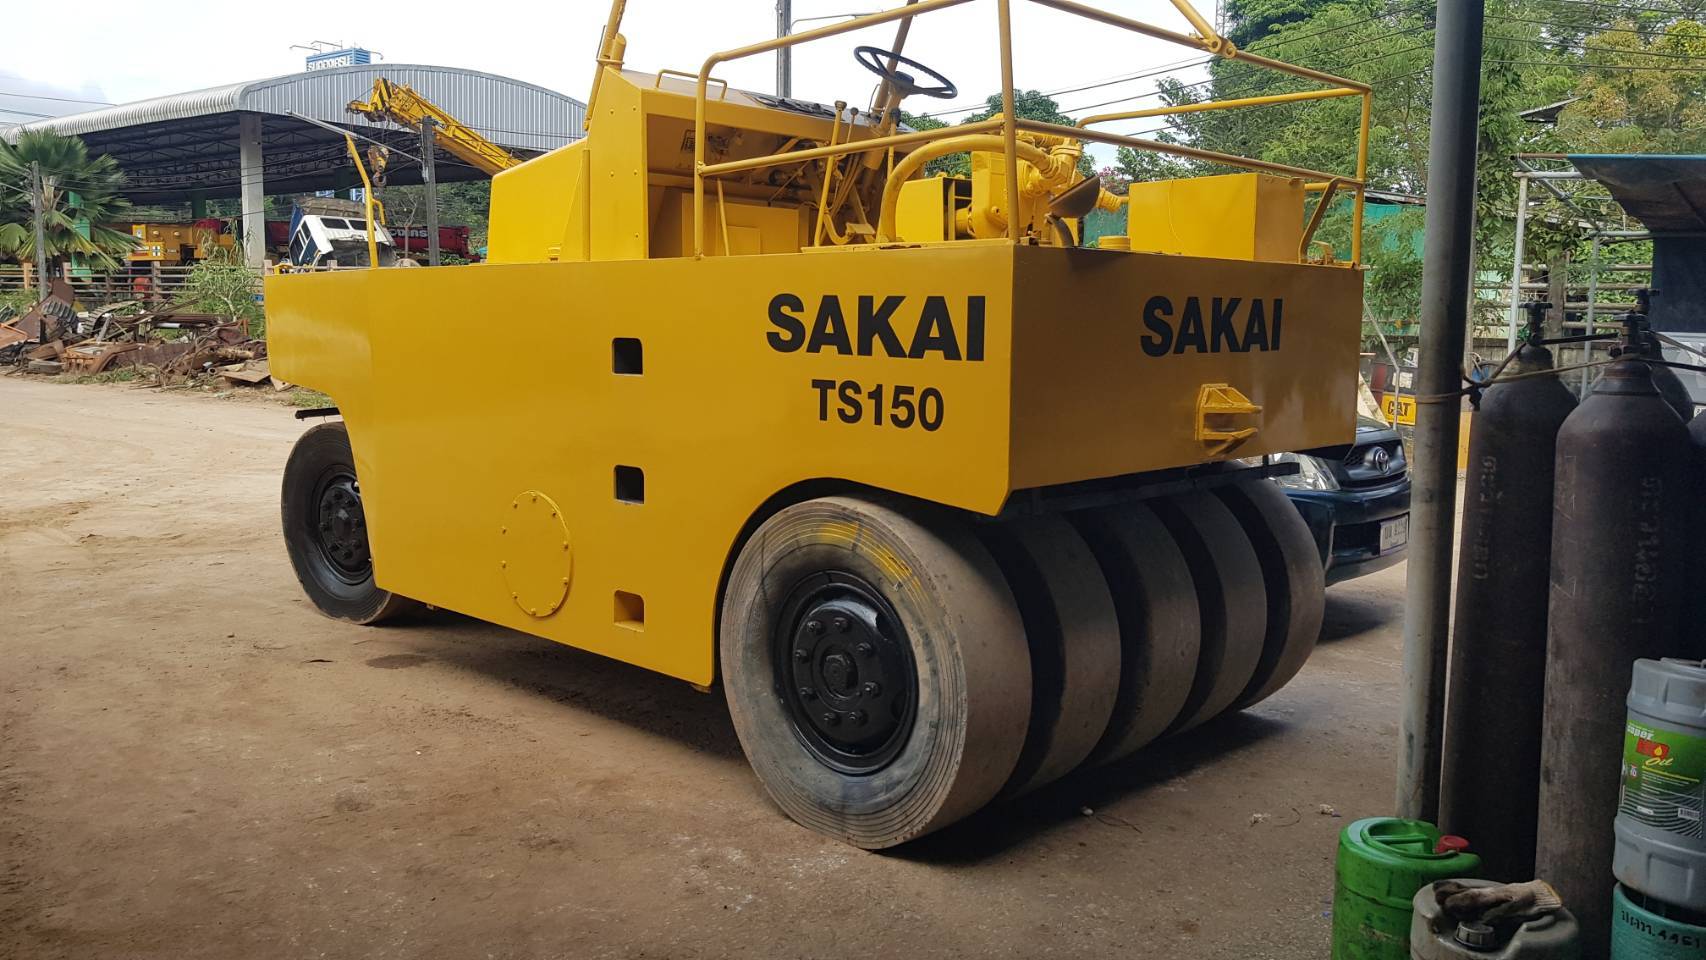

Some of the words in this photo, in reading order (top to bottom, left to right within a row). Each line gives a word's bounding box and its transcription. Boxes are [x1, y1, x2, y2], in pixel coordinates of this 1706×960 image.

[766, 293, 986, 362] SAKAI
[1140, 295, 1283, 358] SAKAI
[811, 379, 945, 433] TS150
[1387, 400, 1410, 417] CAT
